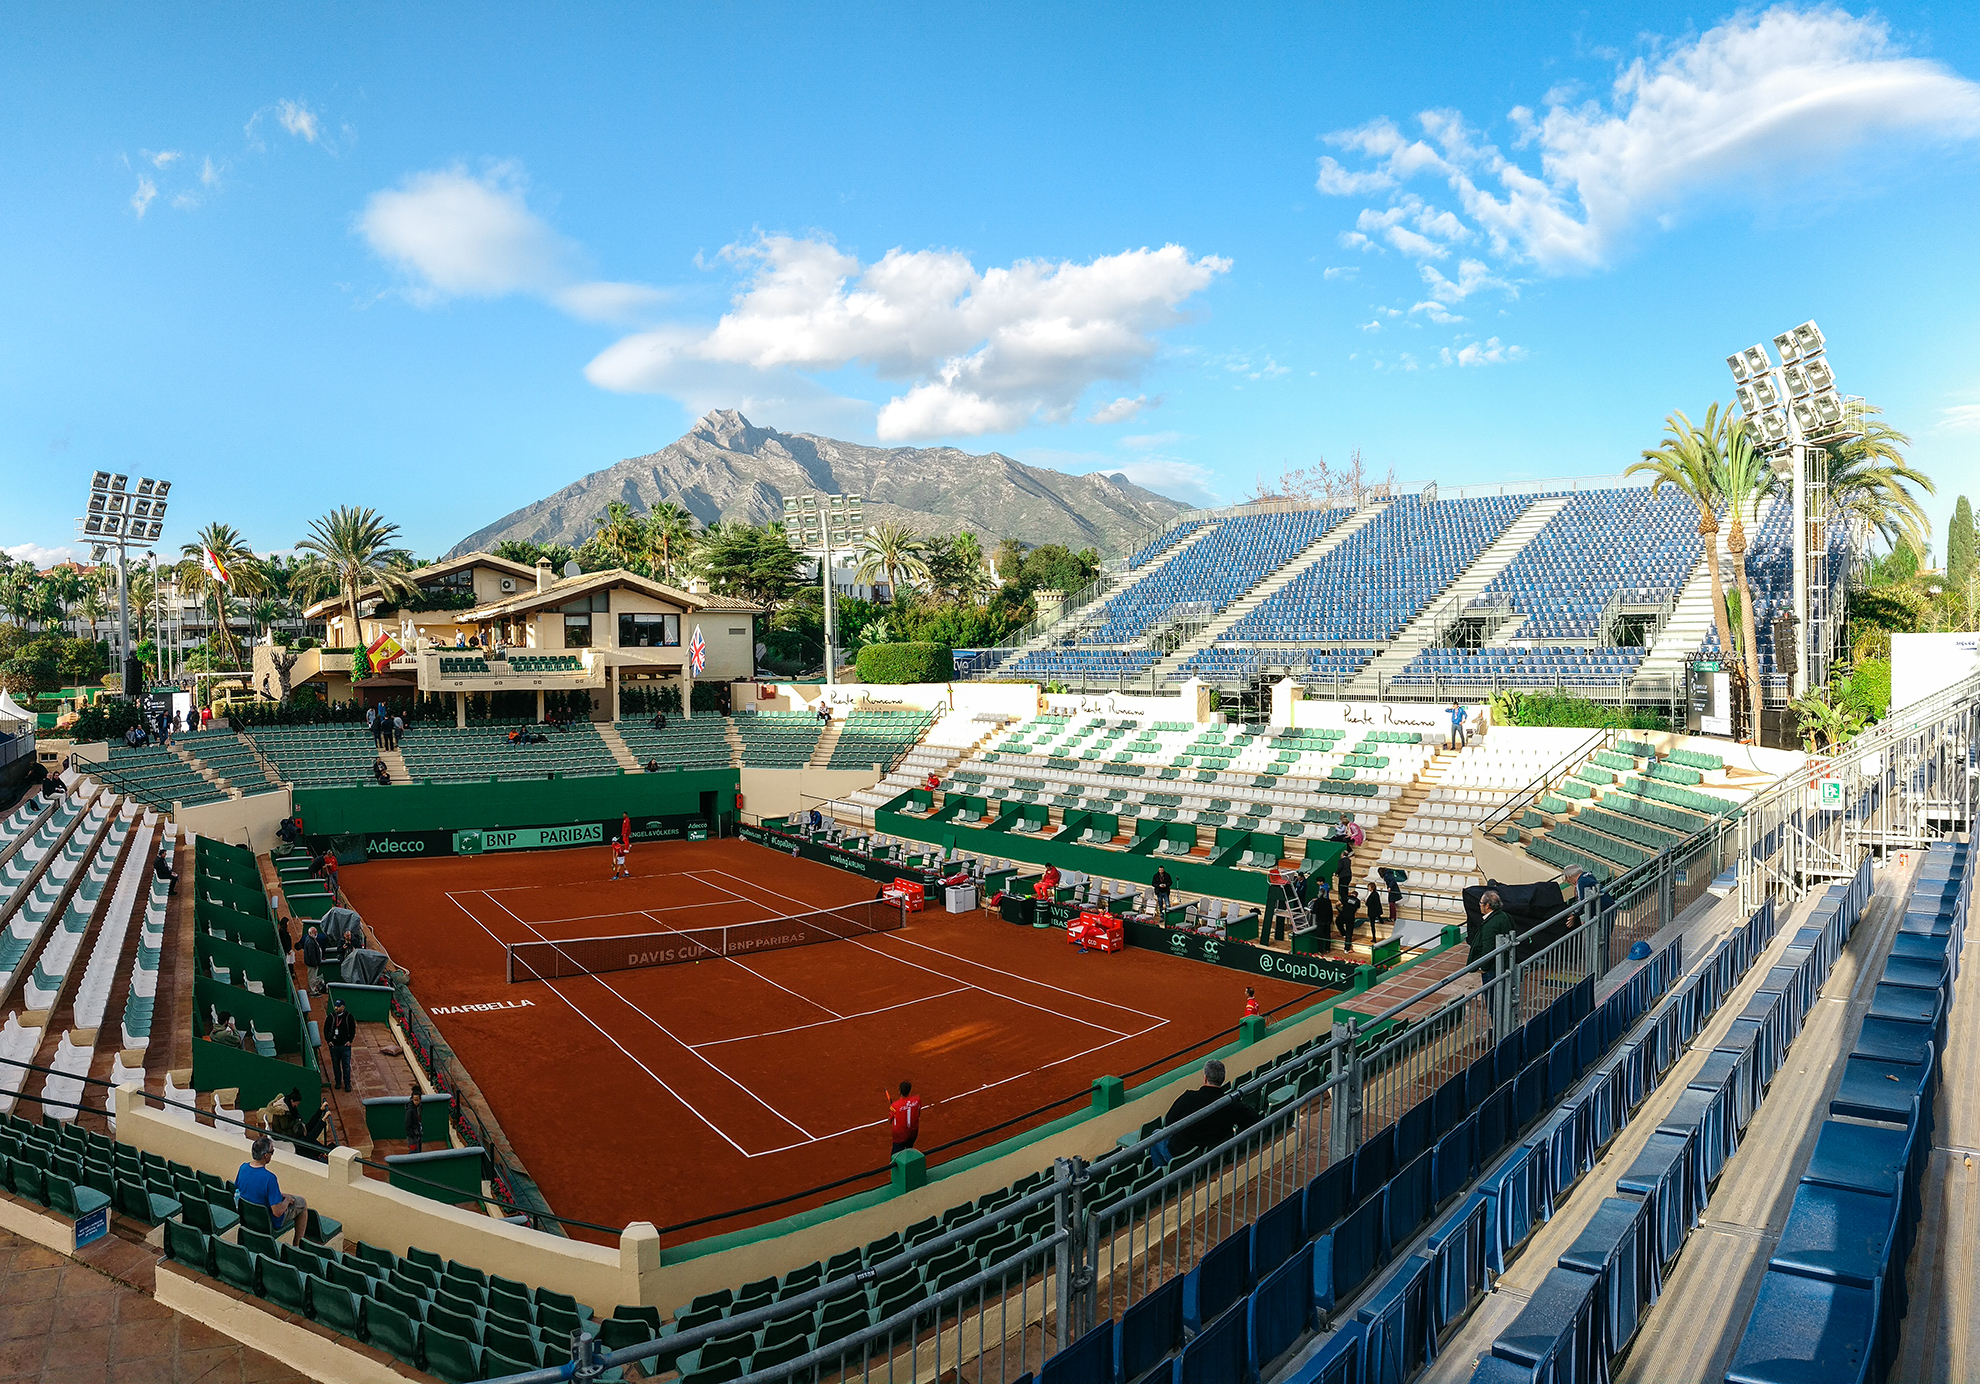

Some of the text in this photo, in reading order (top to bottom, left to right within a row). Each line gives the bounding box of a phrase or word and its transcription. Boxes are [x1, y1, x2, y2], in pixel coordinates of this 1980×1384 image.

[486, 826, 601, 847] BNP PARIBAS
[366, 839, 424, 853] Adecco
[629, 949, 675, 966] DAVIS
[678, 945, 706, 959] CUP
[729, 941, 754, 951] BNP
[756, 933, 805, 947] PARIBAS
[430, 999, 536, 1015] MARBELLA
